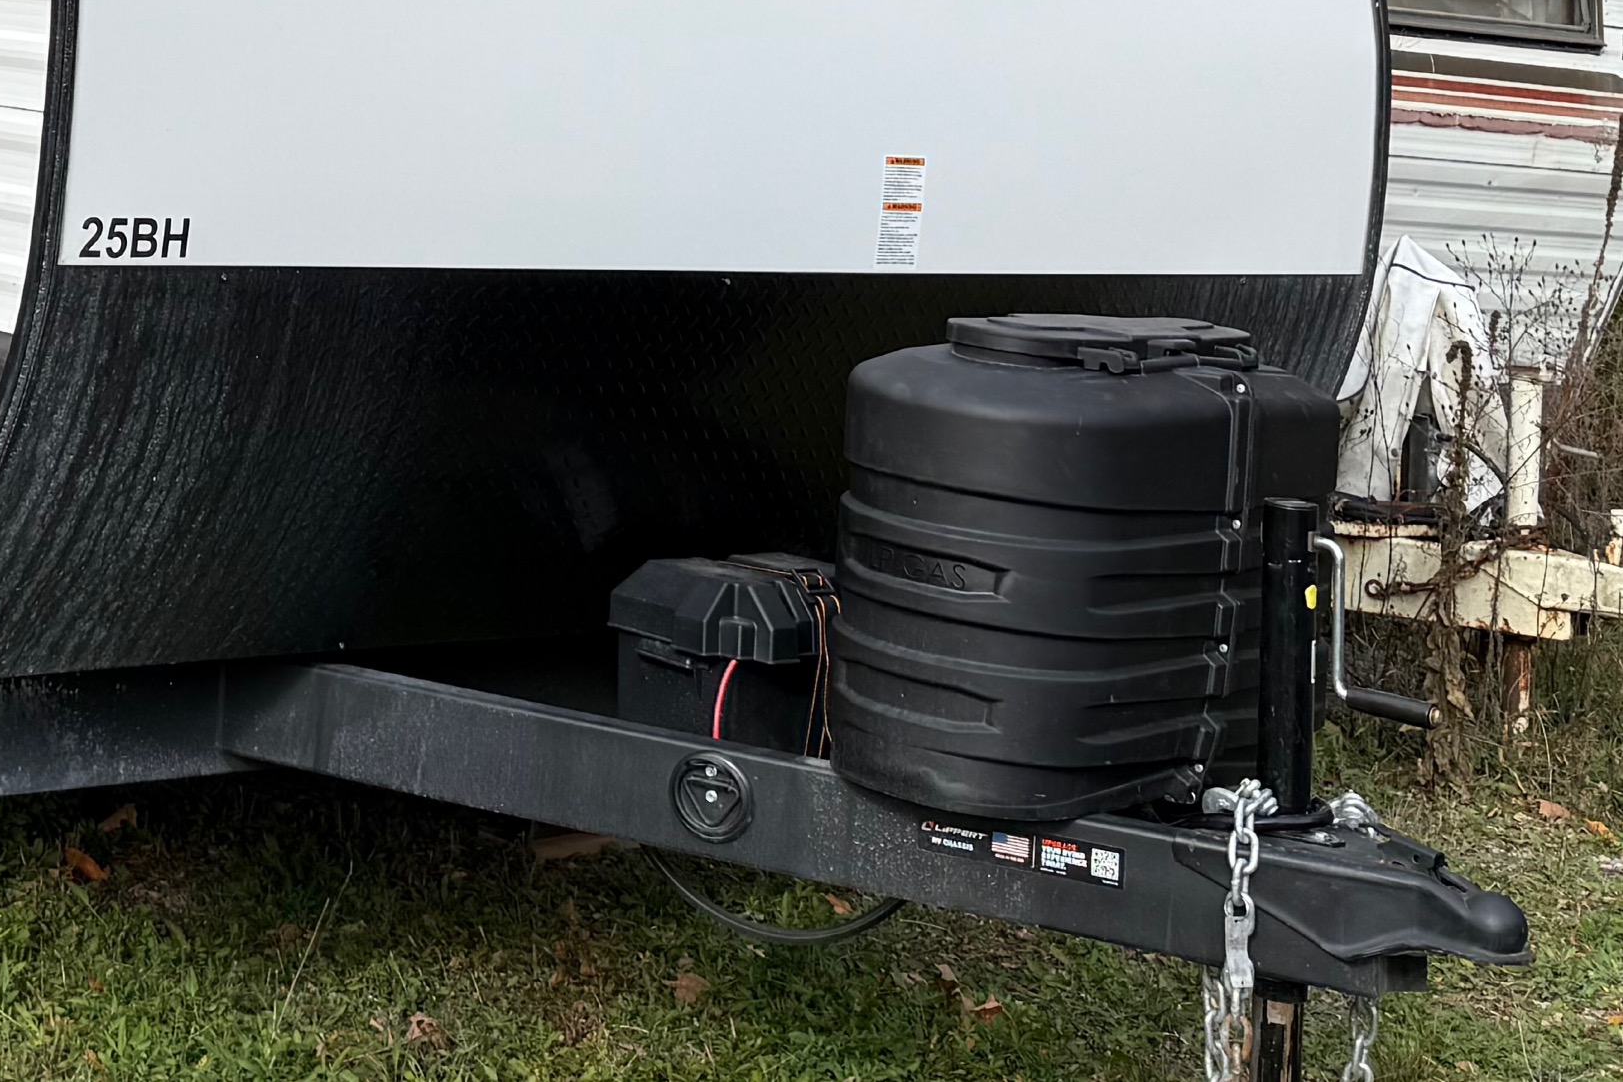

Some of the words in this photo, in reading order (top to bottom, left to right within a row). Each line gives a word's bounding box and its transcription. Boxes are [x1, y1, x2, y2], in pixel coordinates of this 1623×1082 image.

[78, 217, 191, 259] 25BH
[902, 553, 966, 590] GAS
[934, 824, 988, 840] LIPPERT
